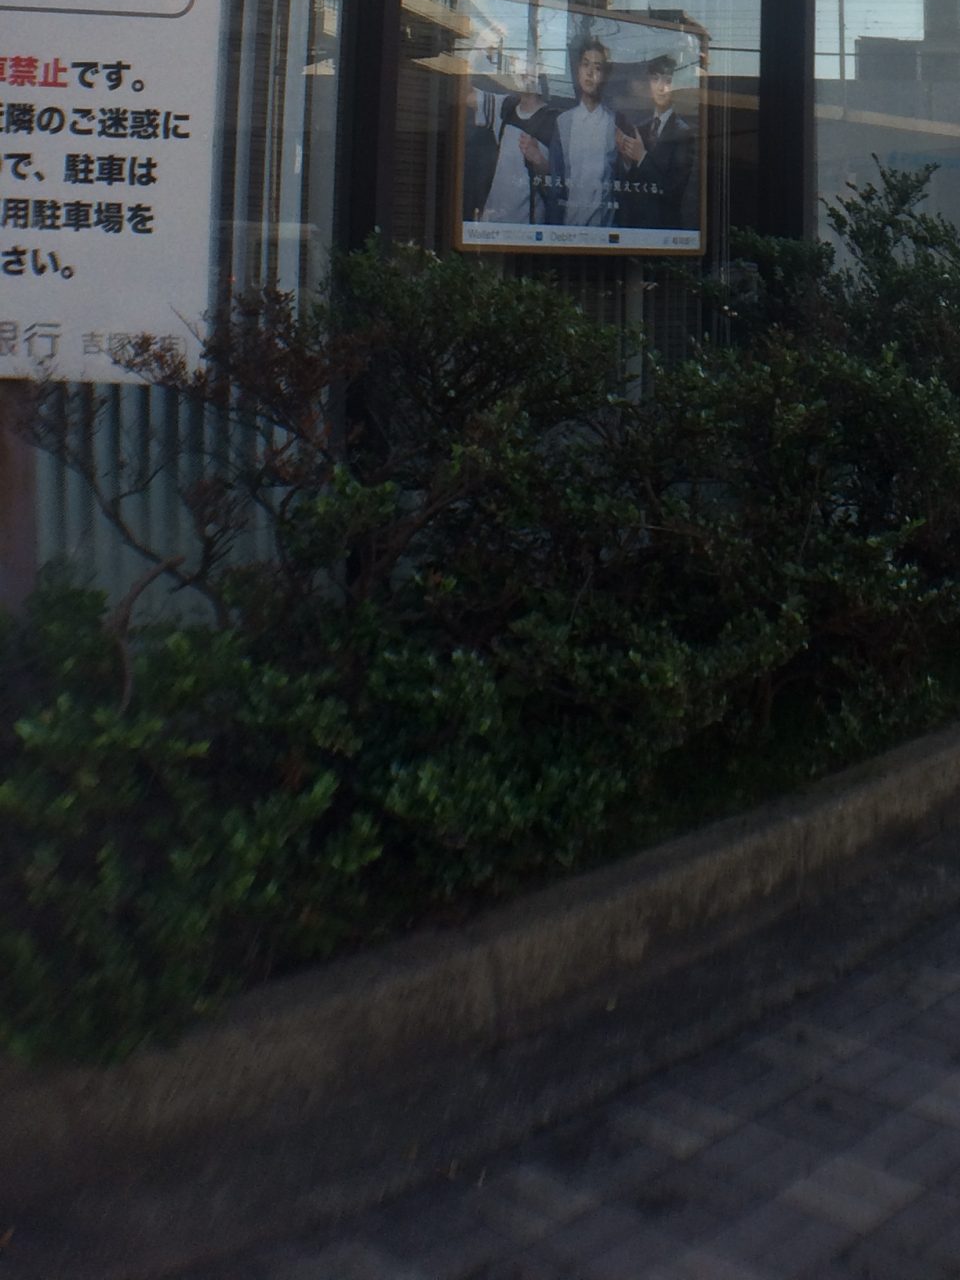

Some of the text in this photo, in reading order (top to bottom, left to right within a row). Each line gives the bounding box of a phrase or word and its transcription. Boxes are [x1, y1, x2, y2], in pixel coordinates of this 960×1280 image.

[0, 55, 145, 93] 禁止です。
[0, 102, 190, 140] 隣のご迷惑に
